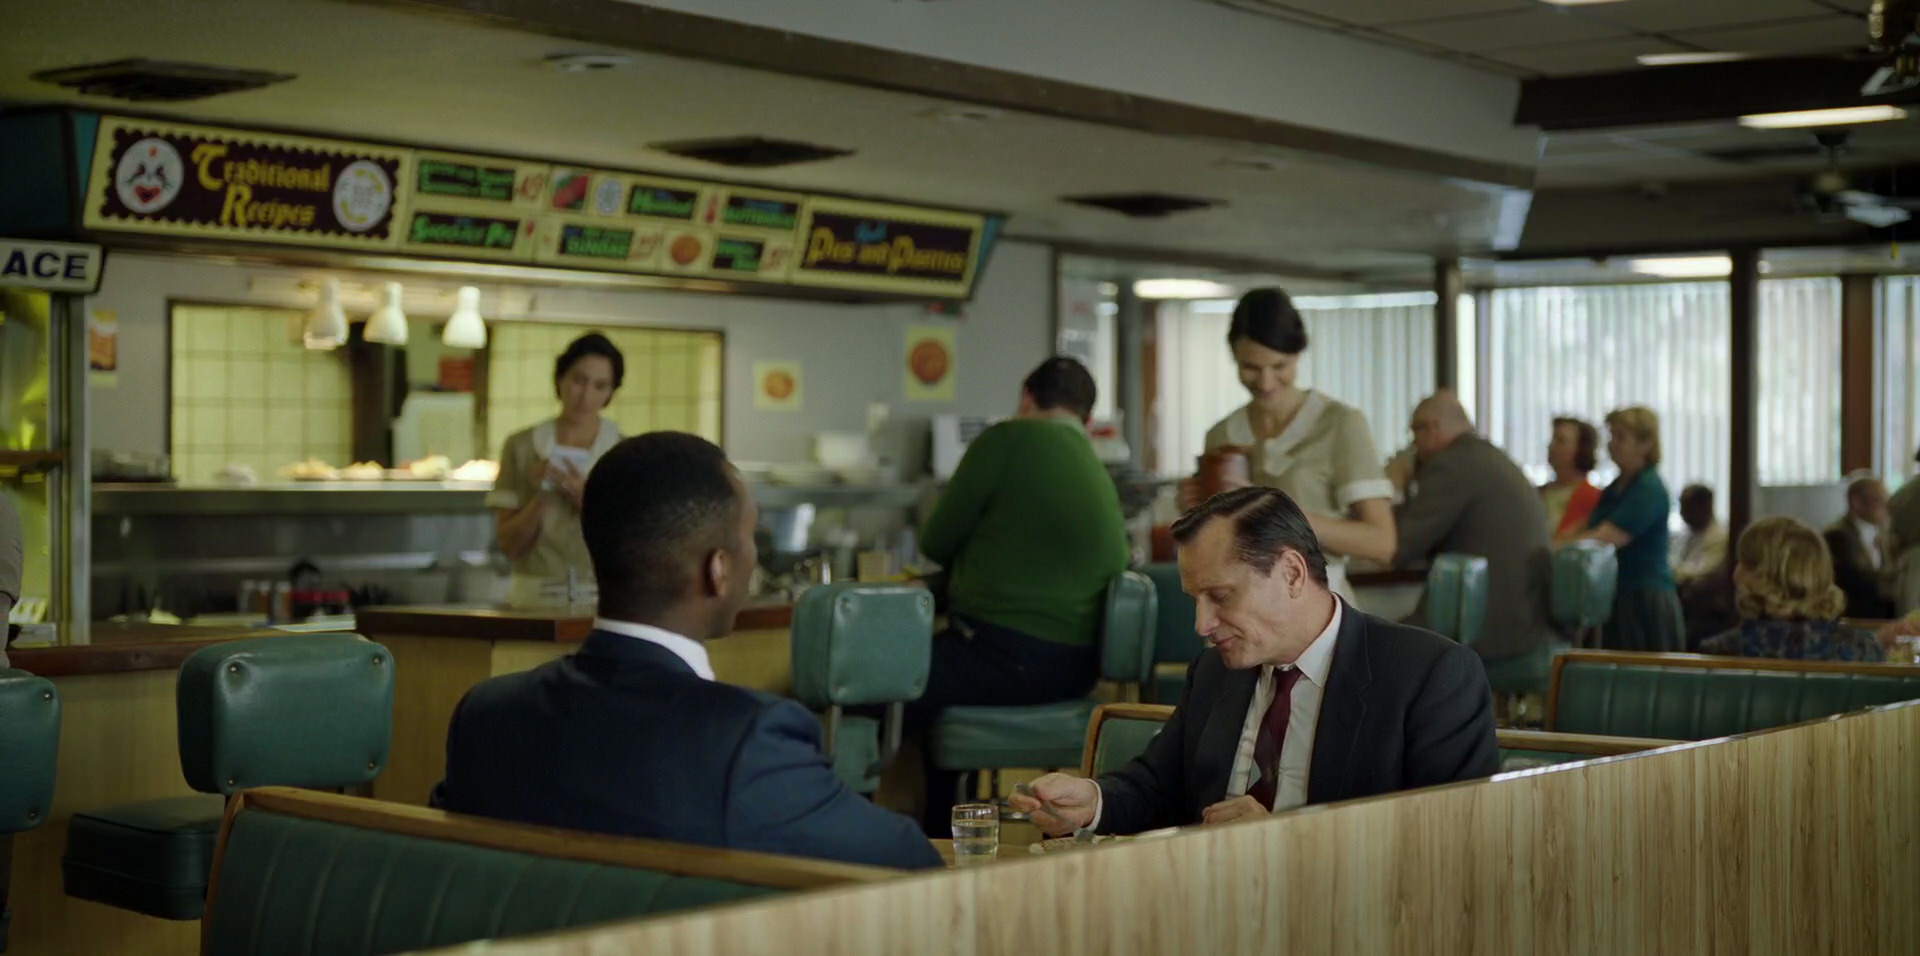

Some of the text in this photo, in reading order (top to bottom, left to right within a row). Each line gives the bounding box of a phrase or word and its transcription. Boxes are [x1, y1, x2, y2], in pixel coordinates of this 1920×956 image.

[191, 143, 331, 192] Traditional
[220, 184, 317, 228] Recipes
[1, 250, 89, 280] ACE
